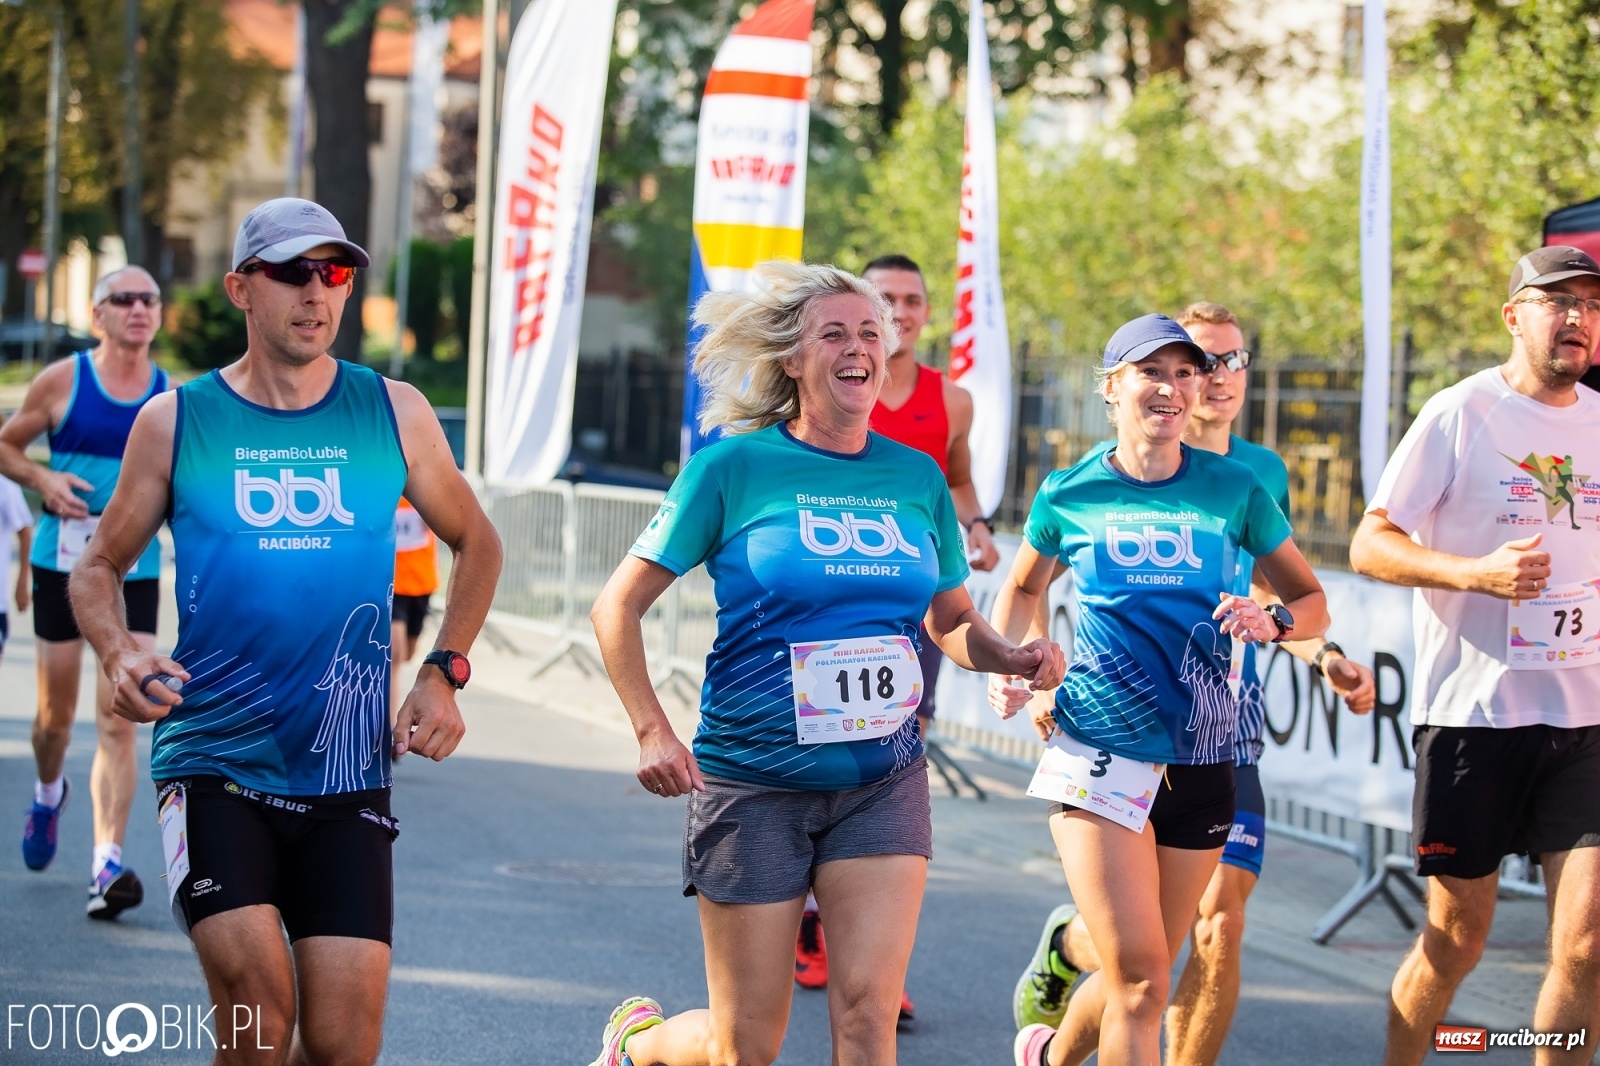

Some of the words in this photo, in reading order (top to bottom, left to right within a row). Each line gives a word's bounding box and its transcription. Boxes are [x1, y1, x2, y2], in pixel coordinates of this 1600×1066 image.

[503, 103, 563, 357] RAFAKO
[235, 446, 348, 462] BiegamBoLubię
[234, 467, 355, 528] bbl
[796, 493, 898, 510] BiegamBoLubię
[1105, 510, 1199, 522] BiegamBoLubię
[258, 535, 331, 550] RACIBÓRZ
[798, 509, 921, 559] bbl
[1105, 525, 1203, 570] bbl
[825, 563, 901, 577] RACIBÓRZ
[1126, 573, 1184, 586] RACIBÓRZ
[1554, 607, 1583, 638] 73
[833, 648, 852, 657] MINI
[854, 646, 885, 655] RAFAKO
[835, 665, 895, 703] 118
[1373, 651, 1414, 769] R
[1089, 750, 1113, 778] 3
